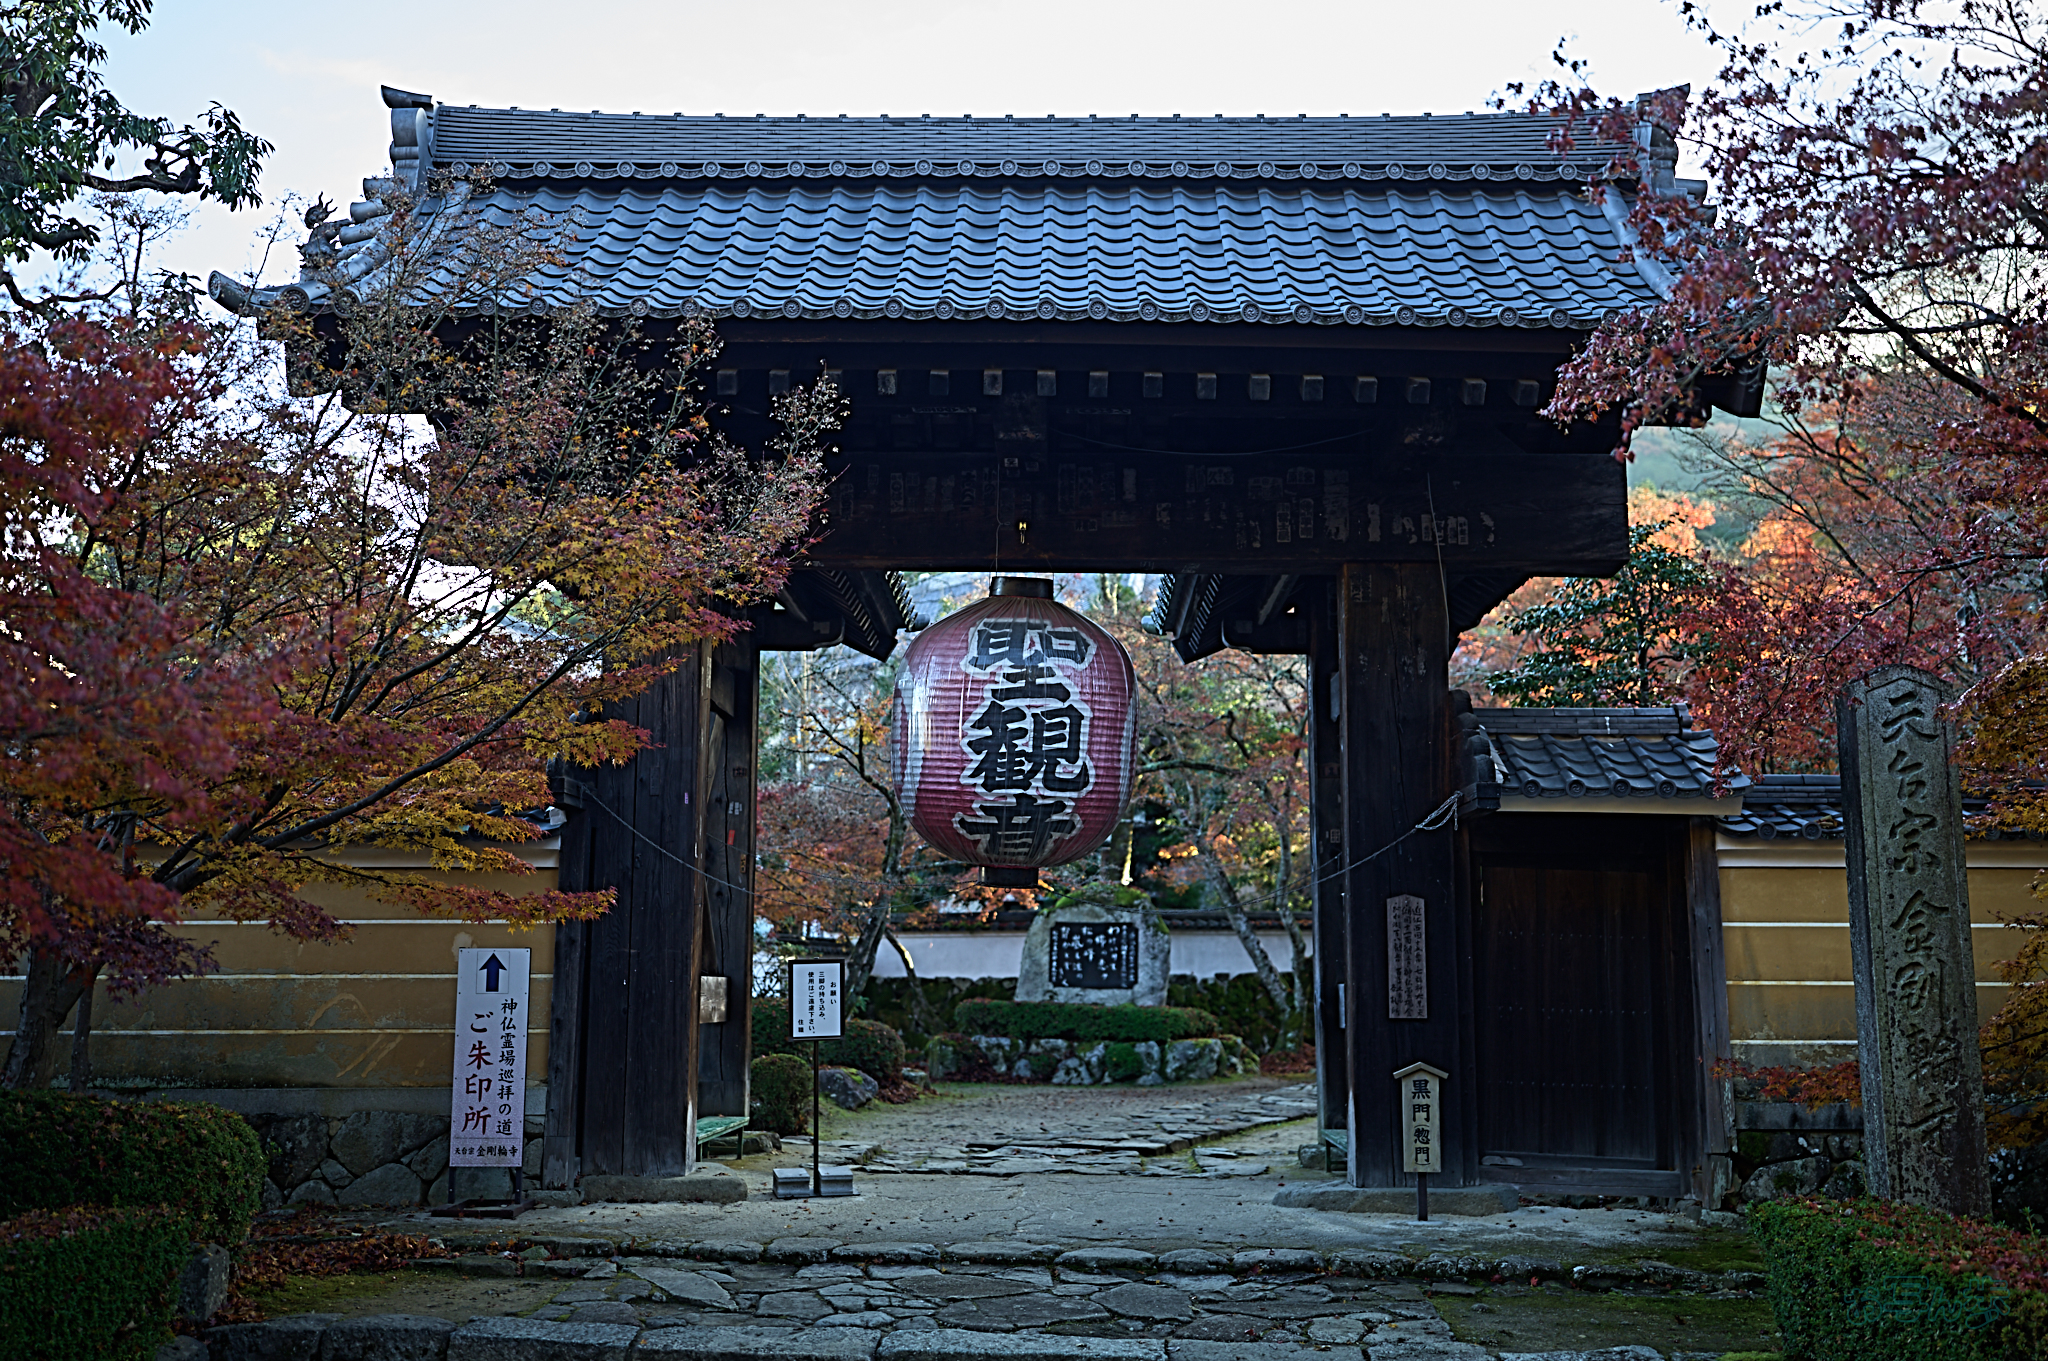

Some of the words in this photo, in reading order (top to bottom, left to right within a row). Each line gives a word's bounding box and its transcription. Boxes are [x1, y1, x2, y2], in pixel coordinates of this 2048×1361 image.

[960, 618, 1097, 858] 聖観音
[797, 1018, 804, 1033] 住職
[829, 981, 837, 1005] お願い
[461, 1011, 494, 1136] ご朱印所
[496, 998, 518, 1136] 神仏霊場巡拝の道
[454, 1146, 475, 1155] 天台宗
[476, 1145, 518, 1157] 金剛輪寺
